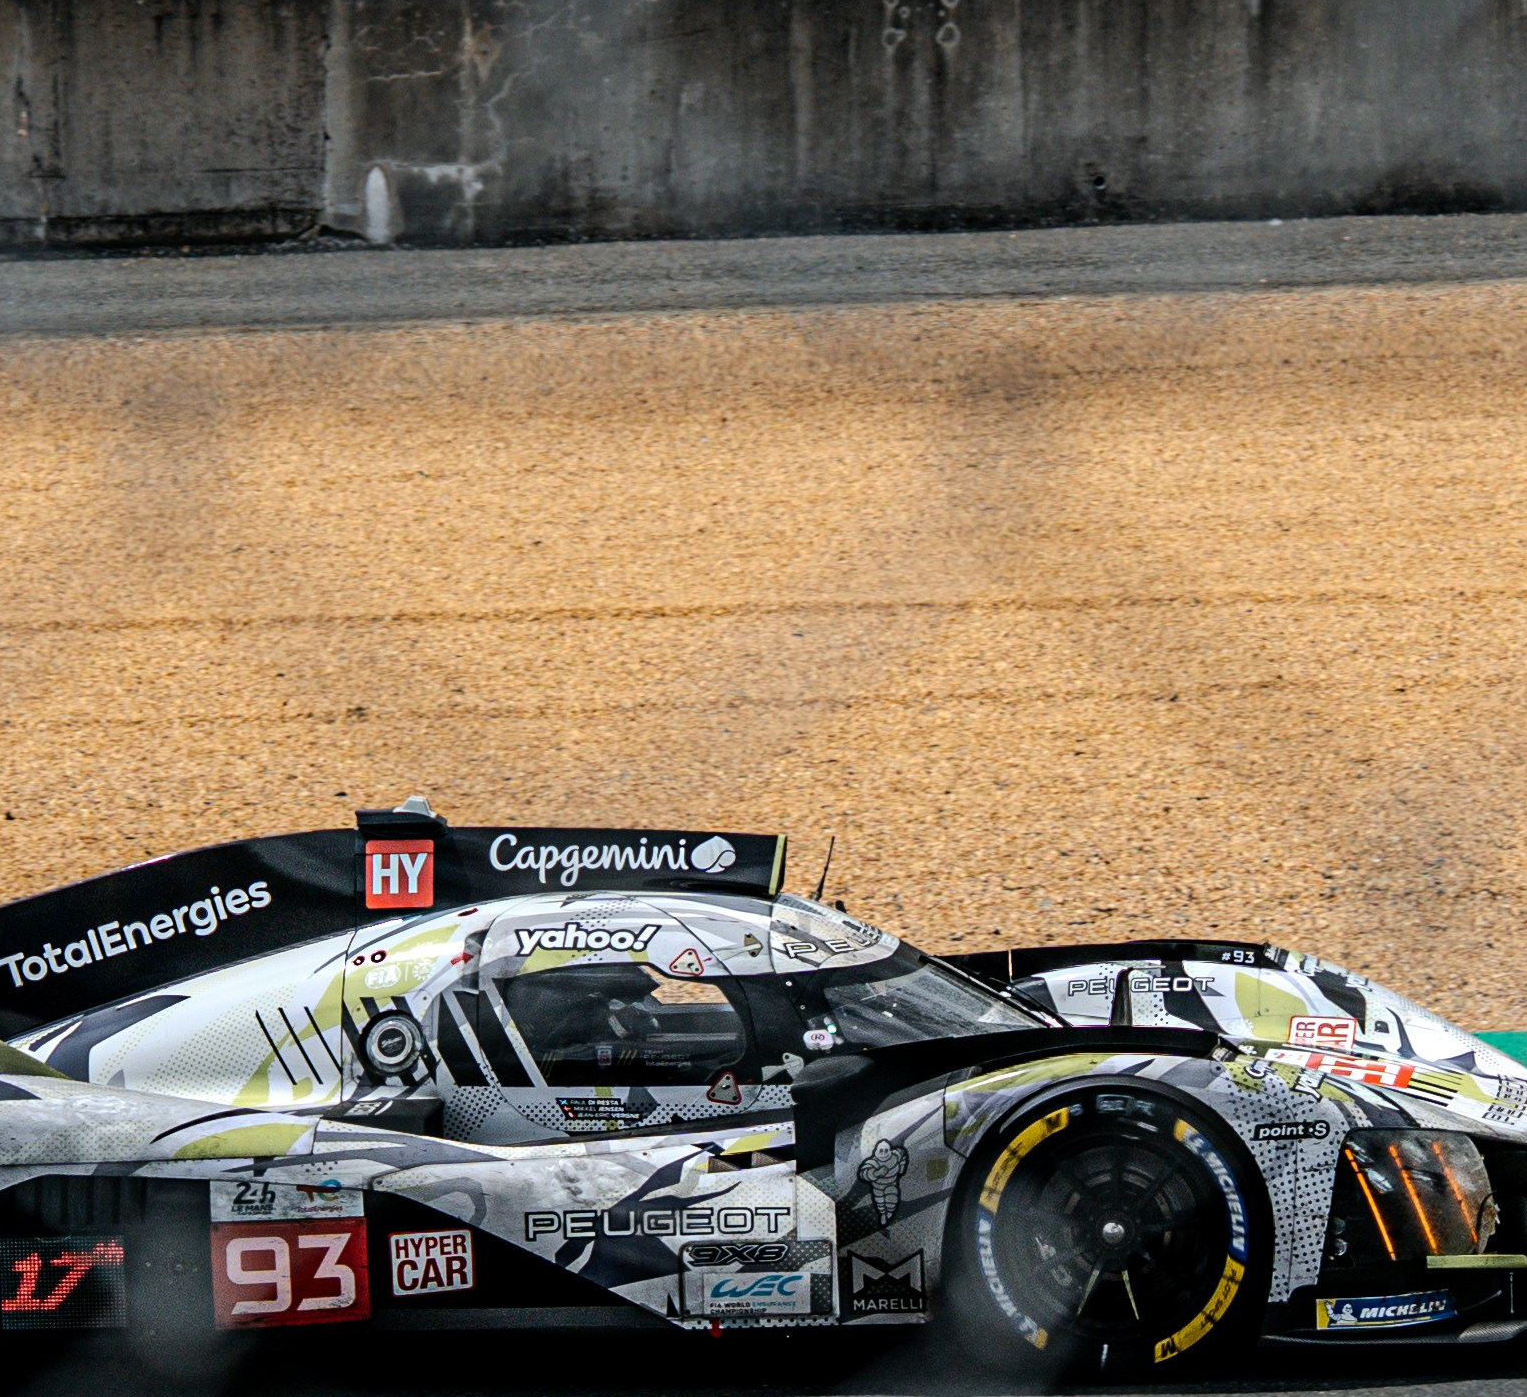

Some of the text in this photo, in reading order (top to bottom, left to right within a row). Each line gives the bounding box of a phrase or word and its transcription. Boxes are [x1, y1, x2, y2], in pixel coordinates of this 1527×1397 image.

[373, 852, 427, 894] HY
[490, 834, 689, 887] Capgemini
[515, 924, 661, 955] yahoo!
[1222, 950, 1255, 963] #93
[1259, 1125, 1304, 1139] point
[1200, 1143, 1246, 1251] MICHELIN
[524, 1207, 790, 1241] PEUGEOT
[395, 1233, 467, 1259] HYPER
[688, 1243, 790, 1266] 9X8
[226, 1232, 356, 1315] 93
[396, 1256, 468, 1291] CAR
[976, 1218, 1021, 1318] MICHELIN
[710, 1274, 803, 1299] WEC
[853, 1298, 923, 1311] MARELLI
